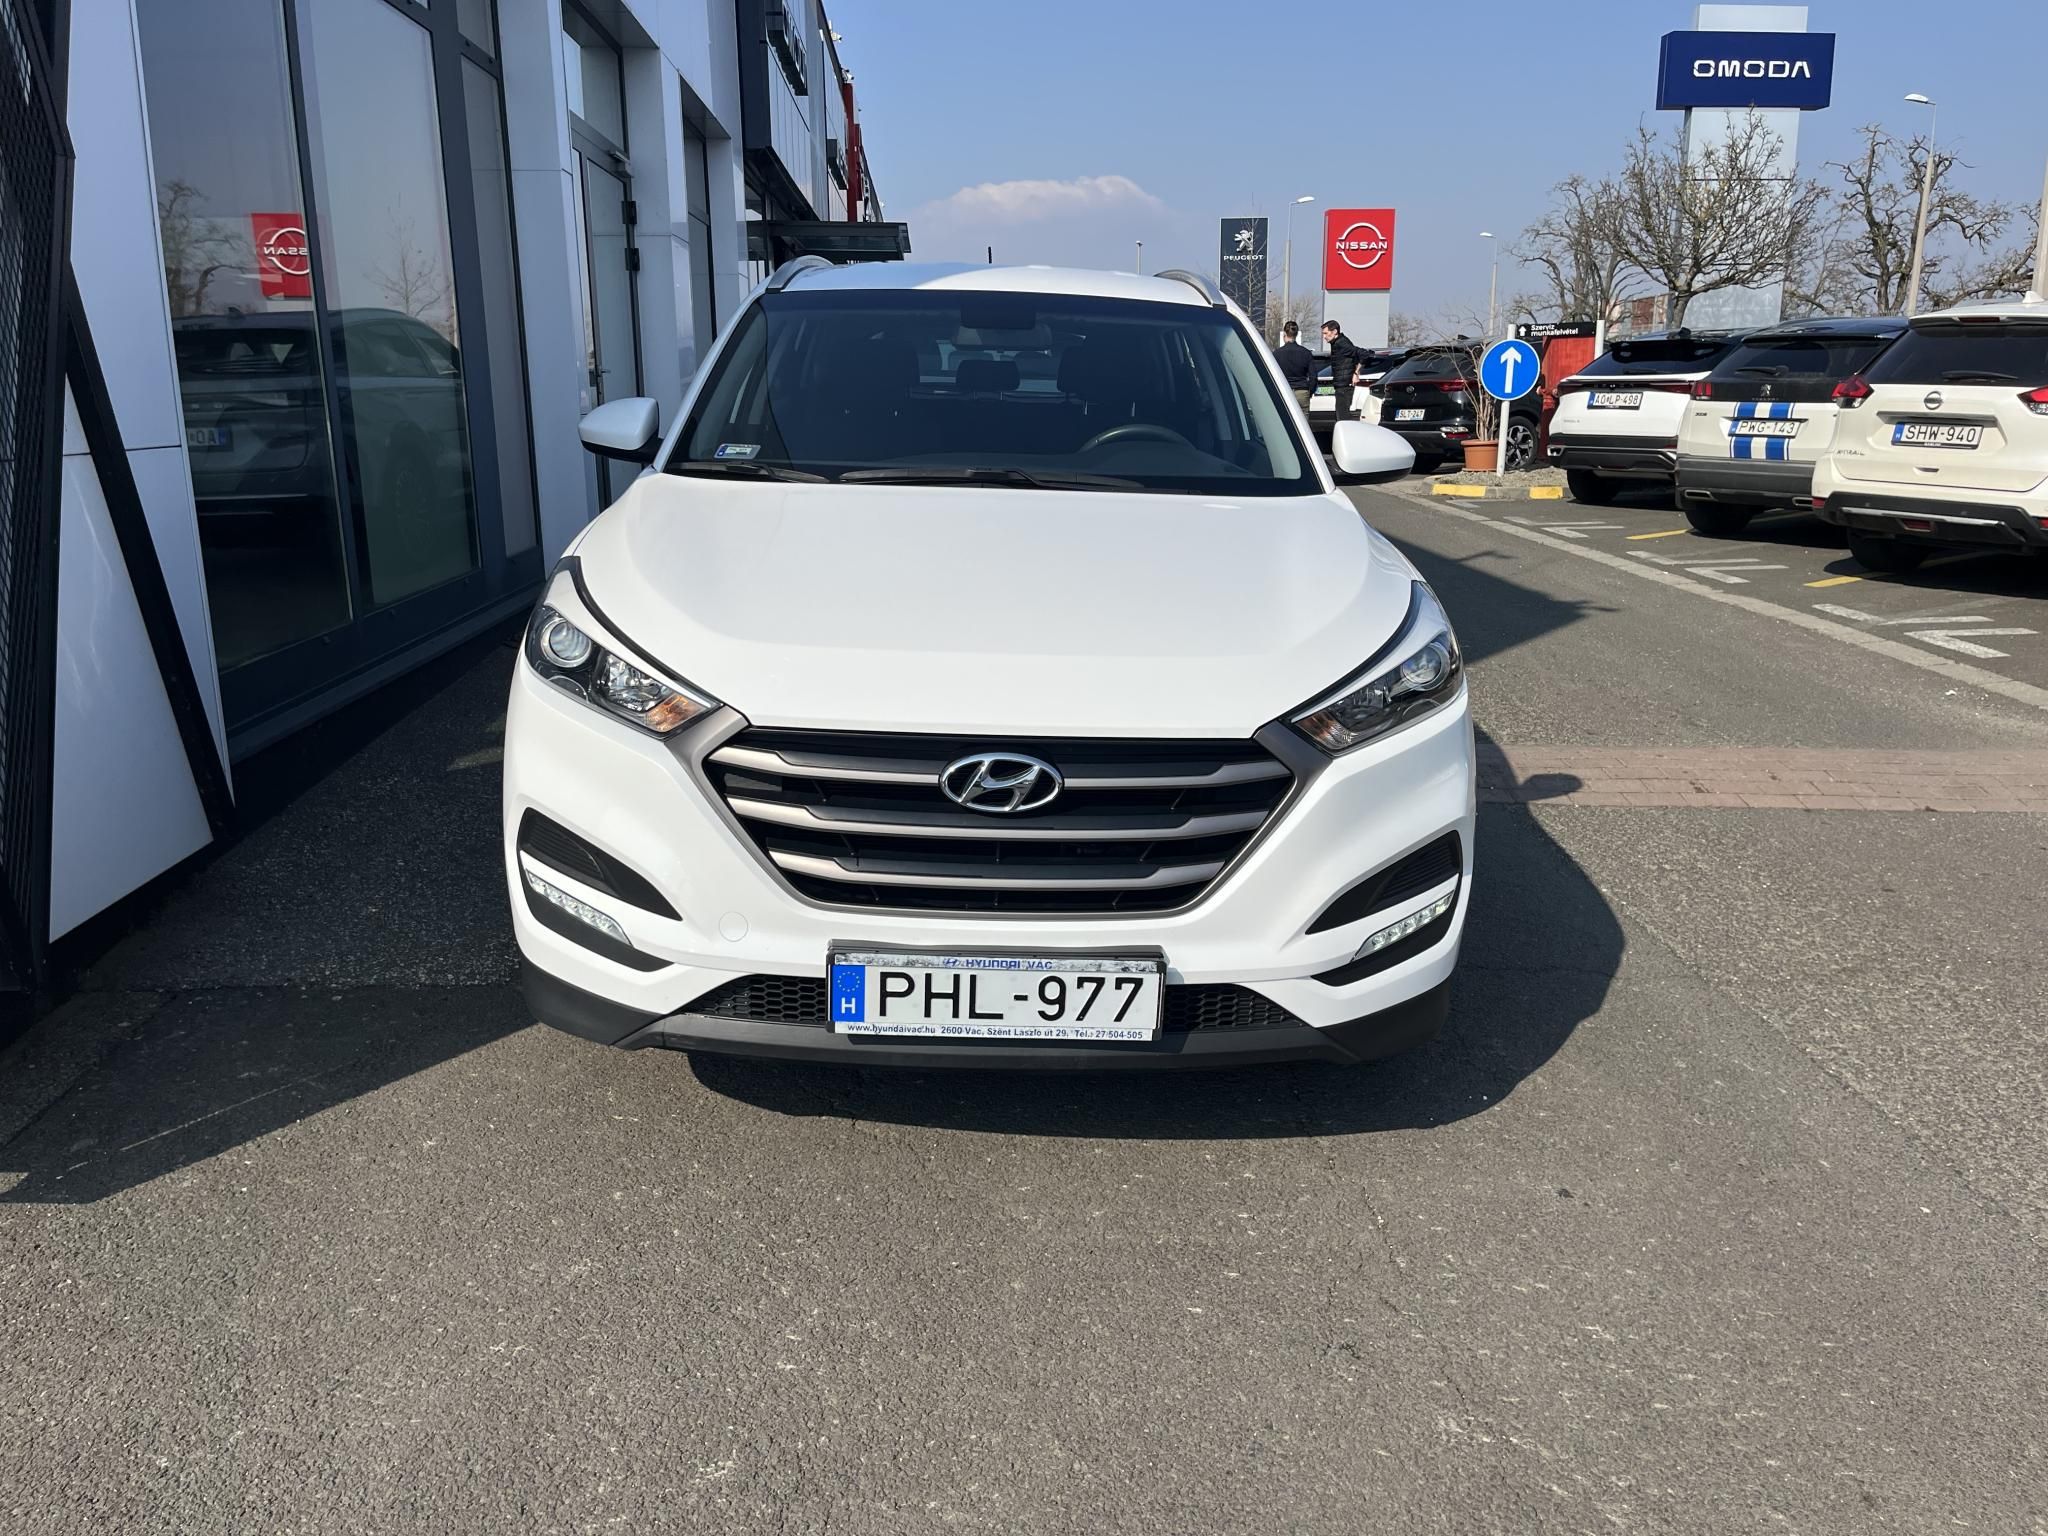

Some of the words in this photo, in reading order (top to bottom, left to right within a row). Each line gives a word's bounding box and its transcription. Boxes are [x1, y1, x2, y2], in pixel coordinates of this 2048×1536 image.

[1693, 59, 1811, 78] OMODA
[1336, 241, 1388, 250] NISSAN
[1531, 328, 1579, 336] munkafelvétel
[1739, 421, 1796, 434] PWG-143
[1905, 424, 1976, 442] SHW-940
[966, 959, 1020, 969] HYUNDAI
[880, 971, 1144, 1023] PHL-977
[841, 997, 856, 1014] H
[847, 1024, 936, 1034] www.hyundaivac.hu
[941, 1026, 963, 1034] 2600
